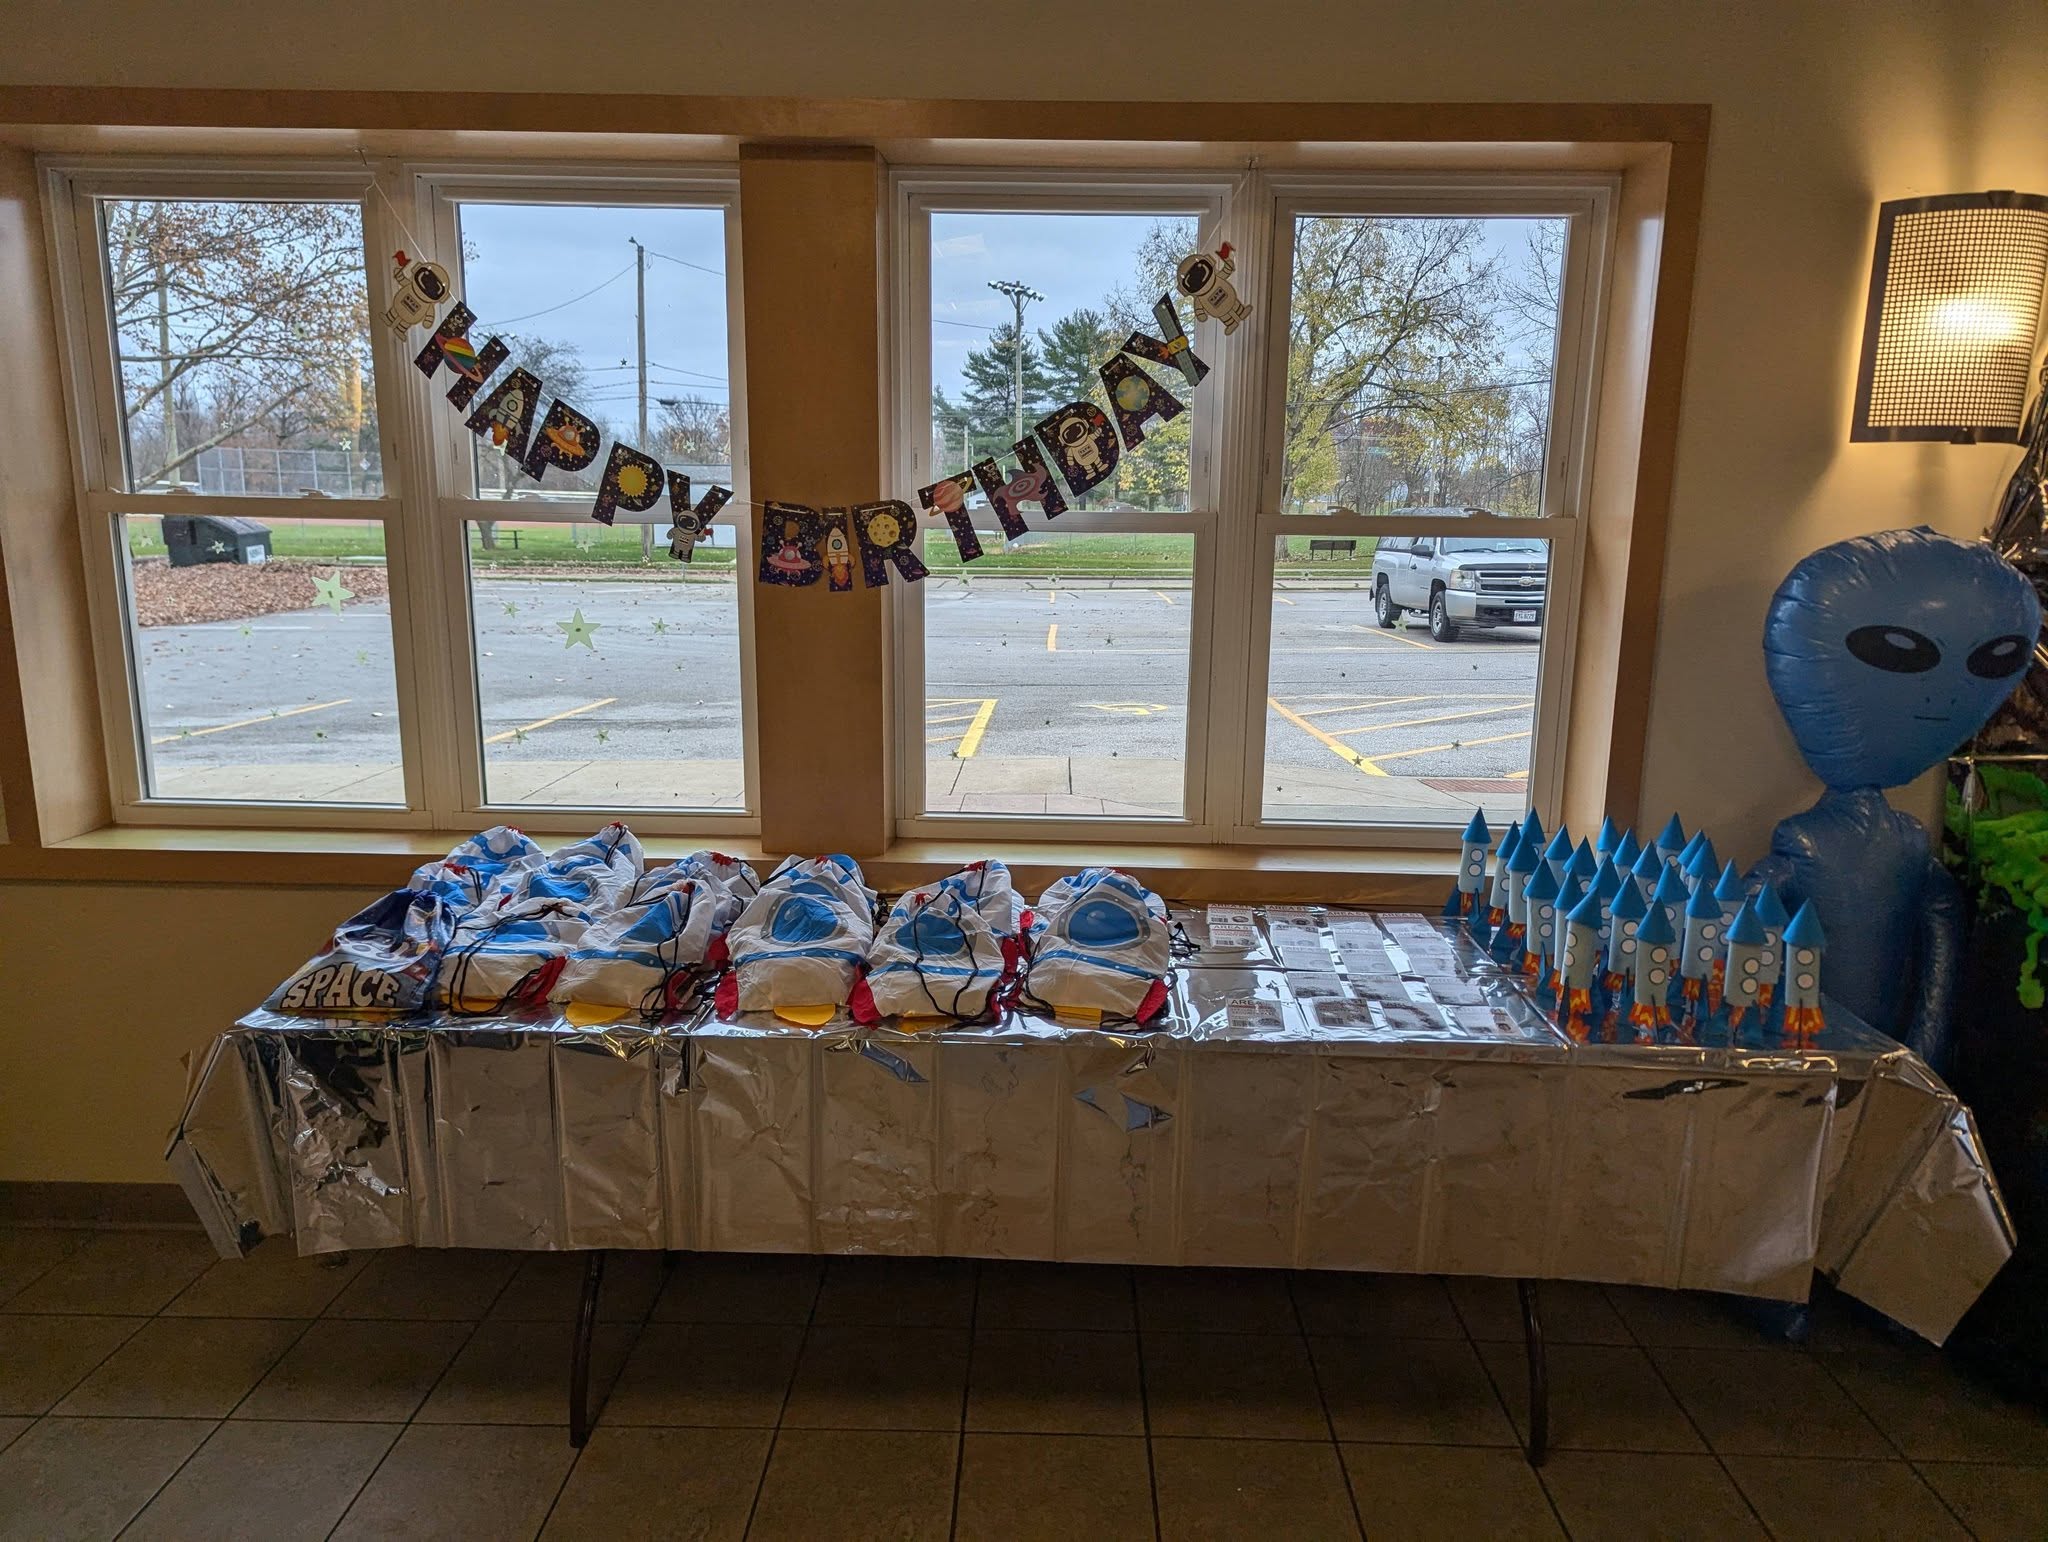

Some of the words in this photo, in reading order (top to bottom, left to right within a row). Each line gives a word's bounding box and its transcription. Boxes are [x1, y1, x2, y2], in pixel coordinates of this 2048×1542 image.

[413, 300, 735, 562] HAPPY
[758, 292, 1210, 592] BIRTHDAY
[281, 961, 401, 1010] SPACE
